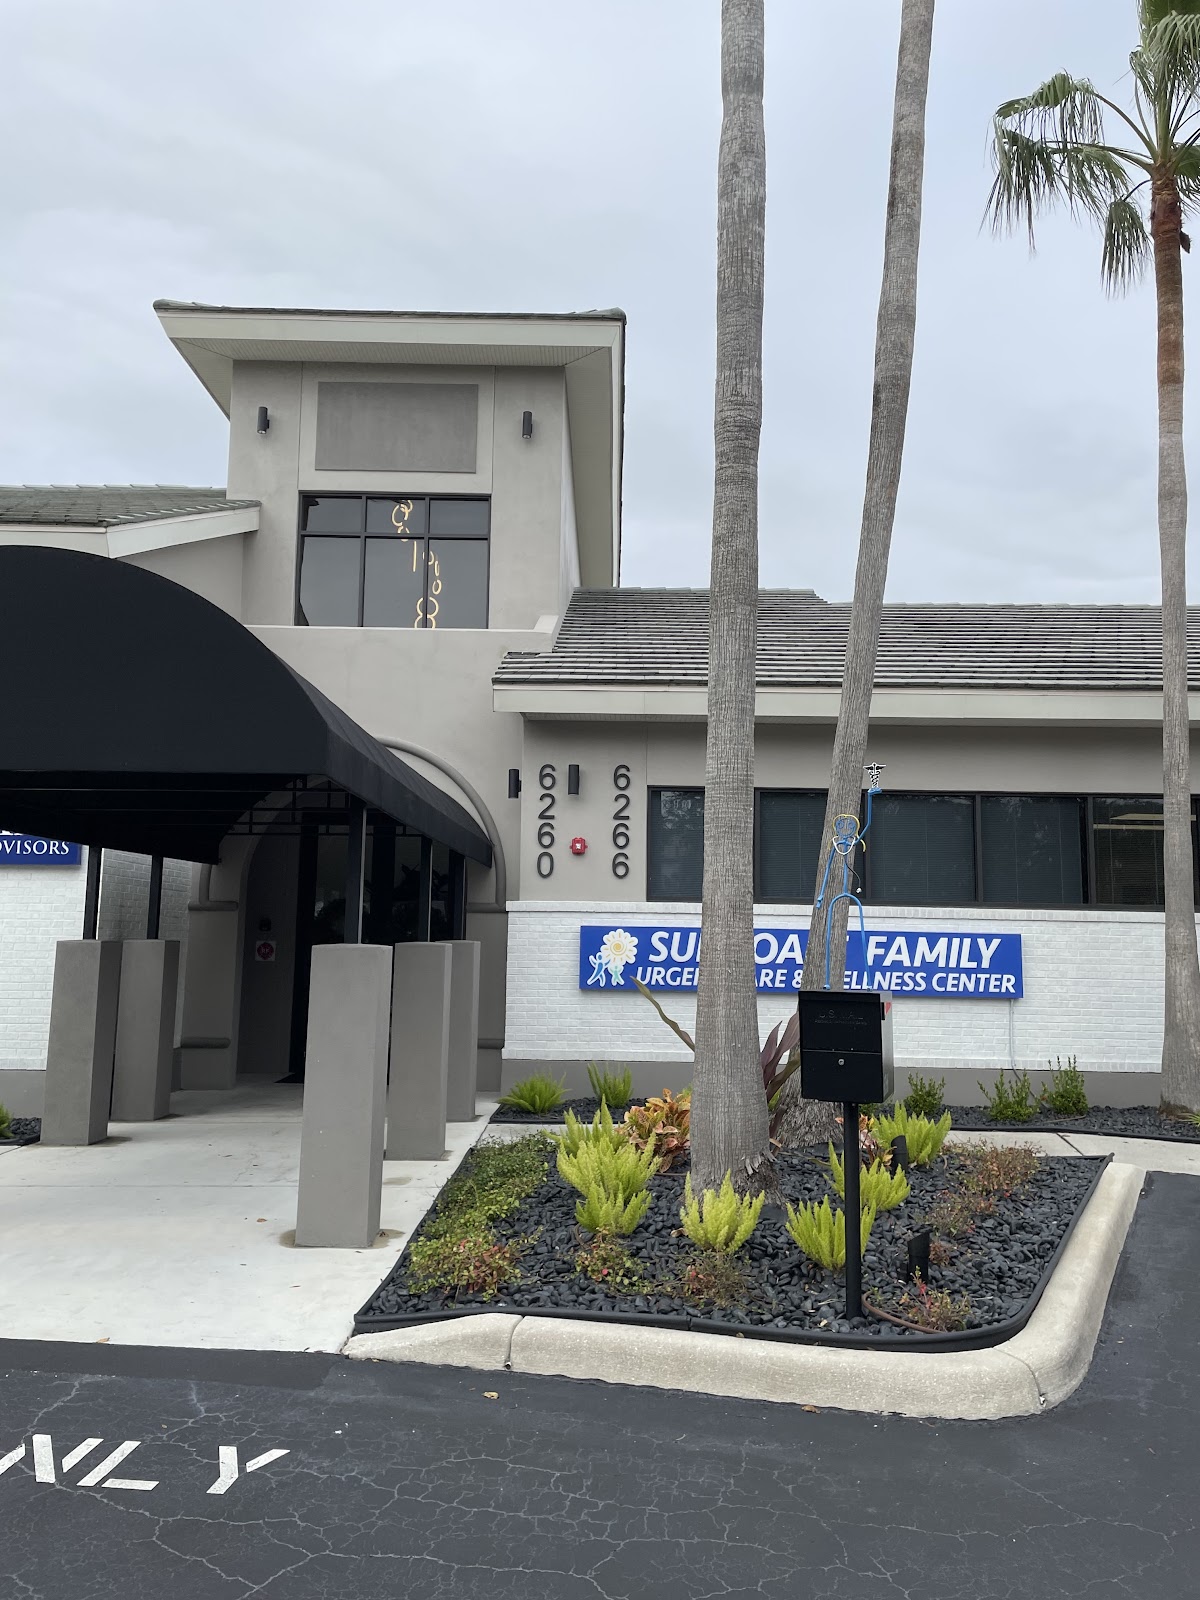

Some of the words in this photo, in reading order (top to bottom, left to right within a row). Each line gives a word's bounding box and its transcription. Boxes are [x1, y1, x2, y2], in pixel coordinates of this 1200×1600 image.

[537, 763, 556, 879] 6260
[612, 764, 631, 880] 6266
[0, 840, 70, 855] VISORS
[867, 935, 1002, 969] FAMILY
[636, 966, 699, 986] URGE
[843, 971, 926, 992] ELLNESS
[931, 973, 1016, 993] CENTER
